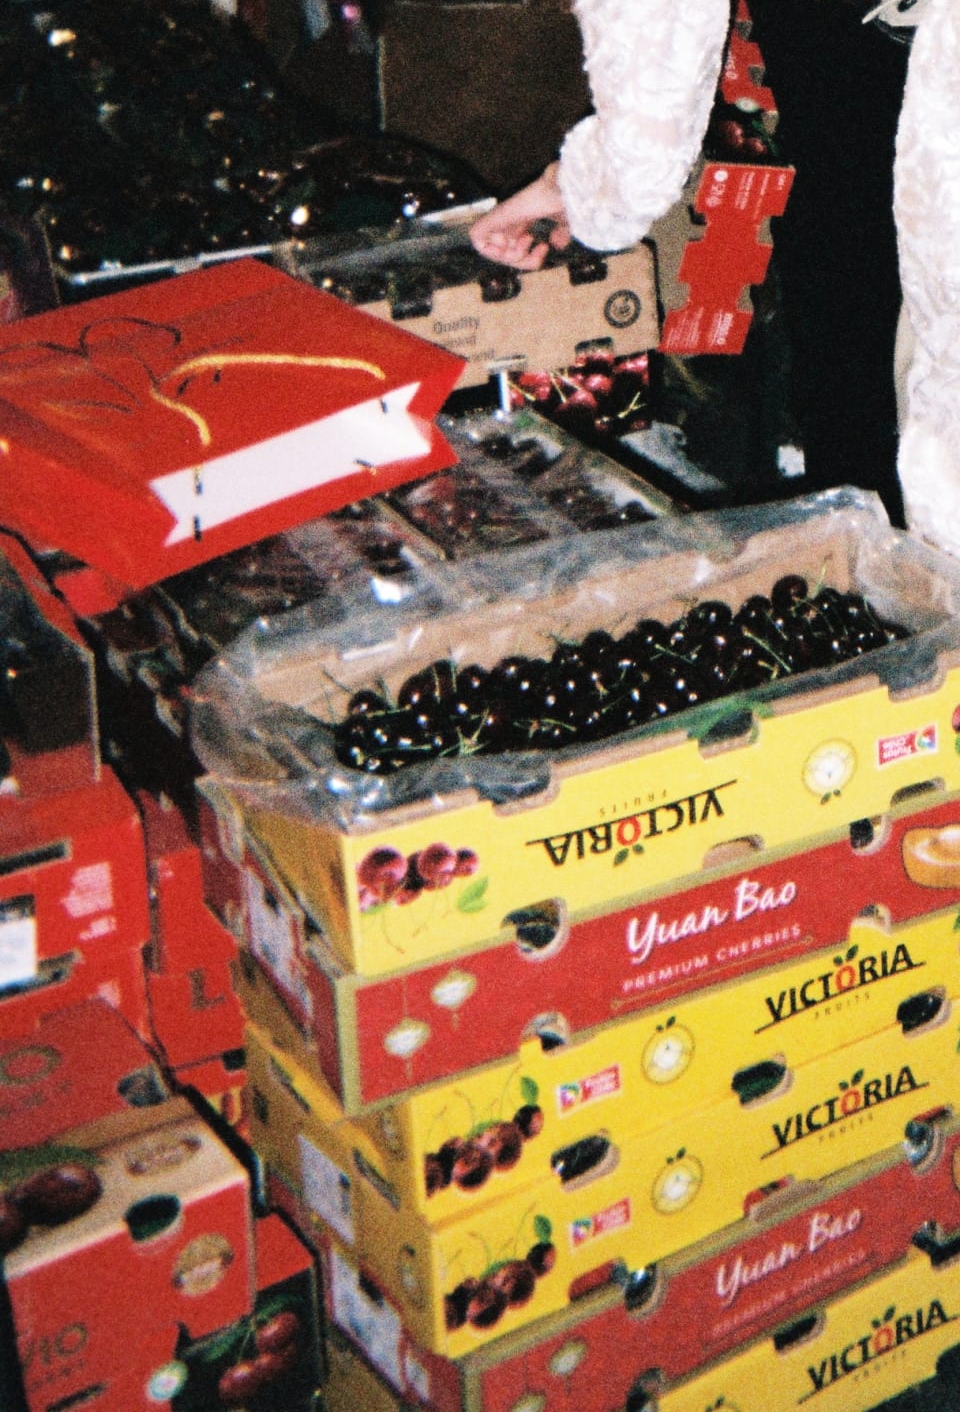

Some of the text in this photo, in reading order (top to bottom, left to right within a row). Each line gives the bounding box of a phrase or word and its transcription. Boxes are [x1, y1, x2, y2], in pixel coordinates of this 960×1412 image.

[542, 787, 725, 867] VICTORIA
[598, 788, 669, 818] FRUITS
[621, 923, 801, 992] PREMIUM CHERRIES
[626, 878, 796, 965] Yuan Bao
[764, 943, 915, 1023] VICTORIA
[813, 990, 871, 1020] FRUITS
[772, 1065, 919, 1148] VICTORIA
[715, 1207, 862, 1310] Yuan Bao
[807, 1299, 949, 1390] VICTORIA
